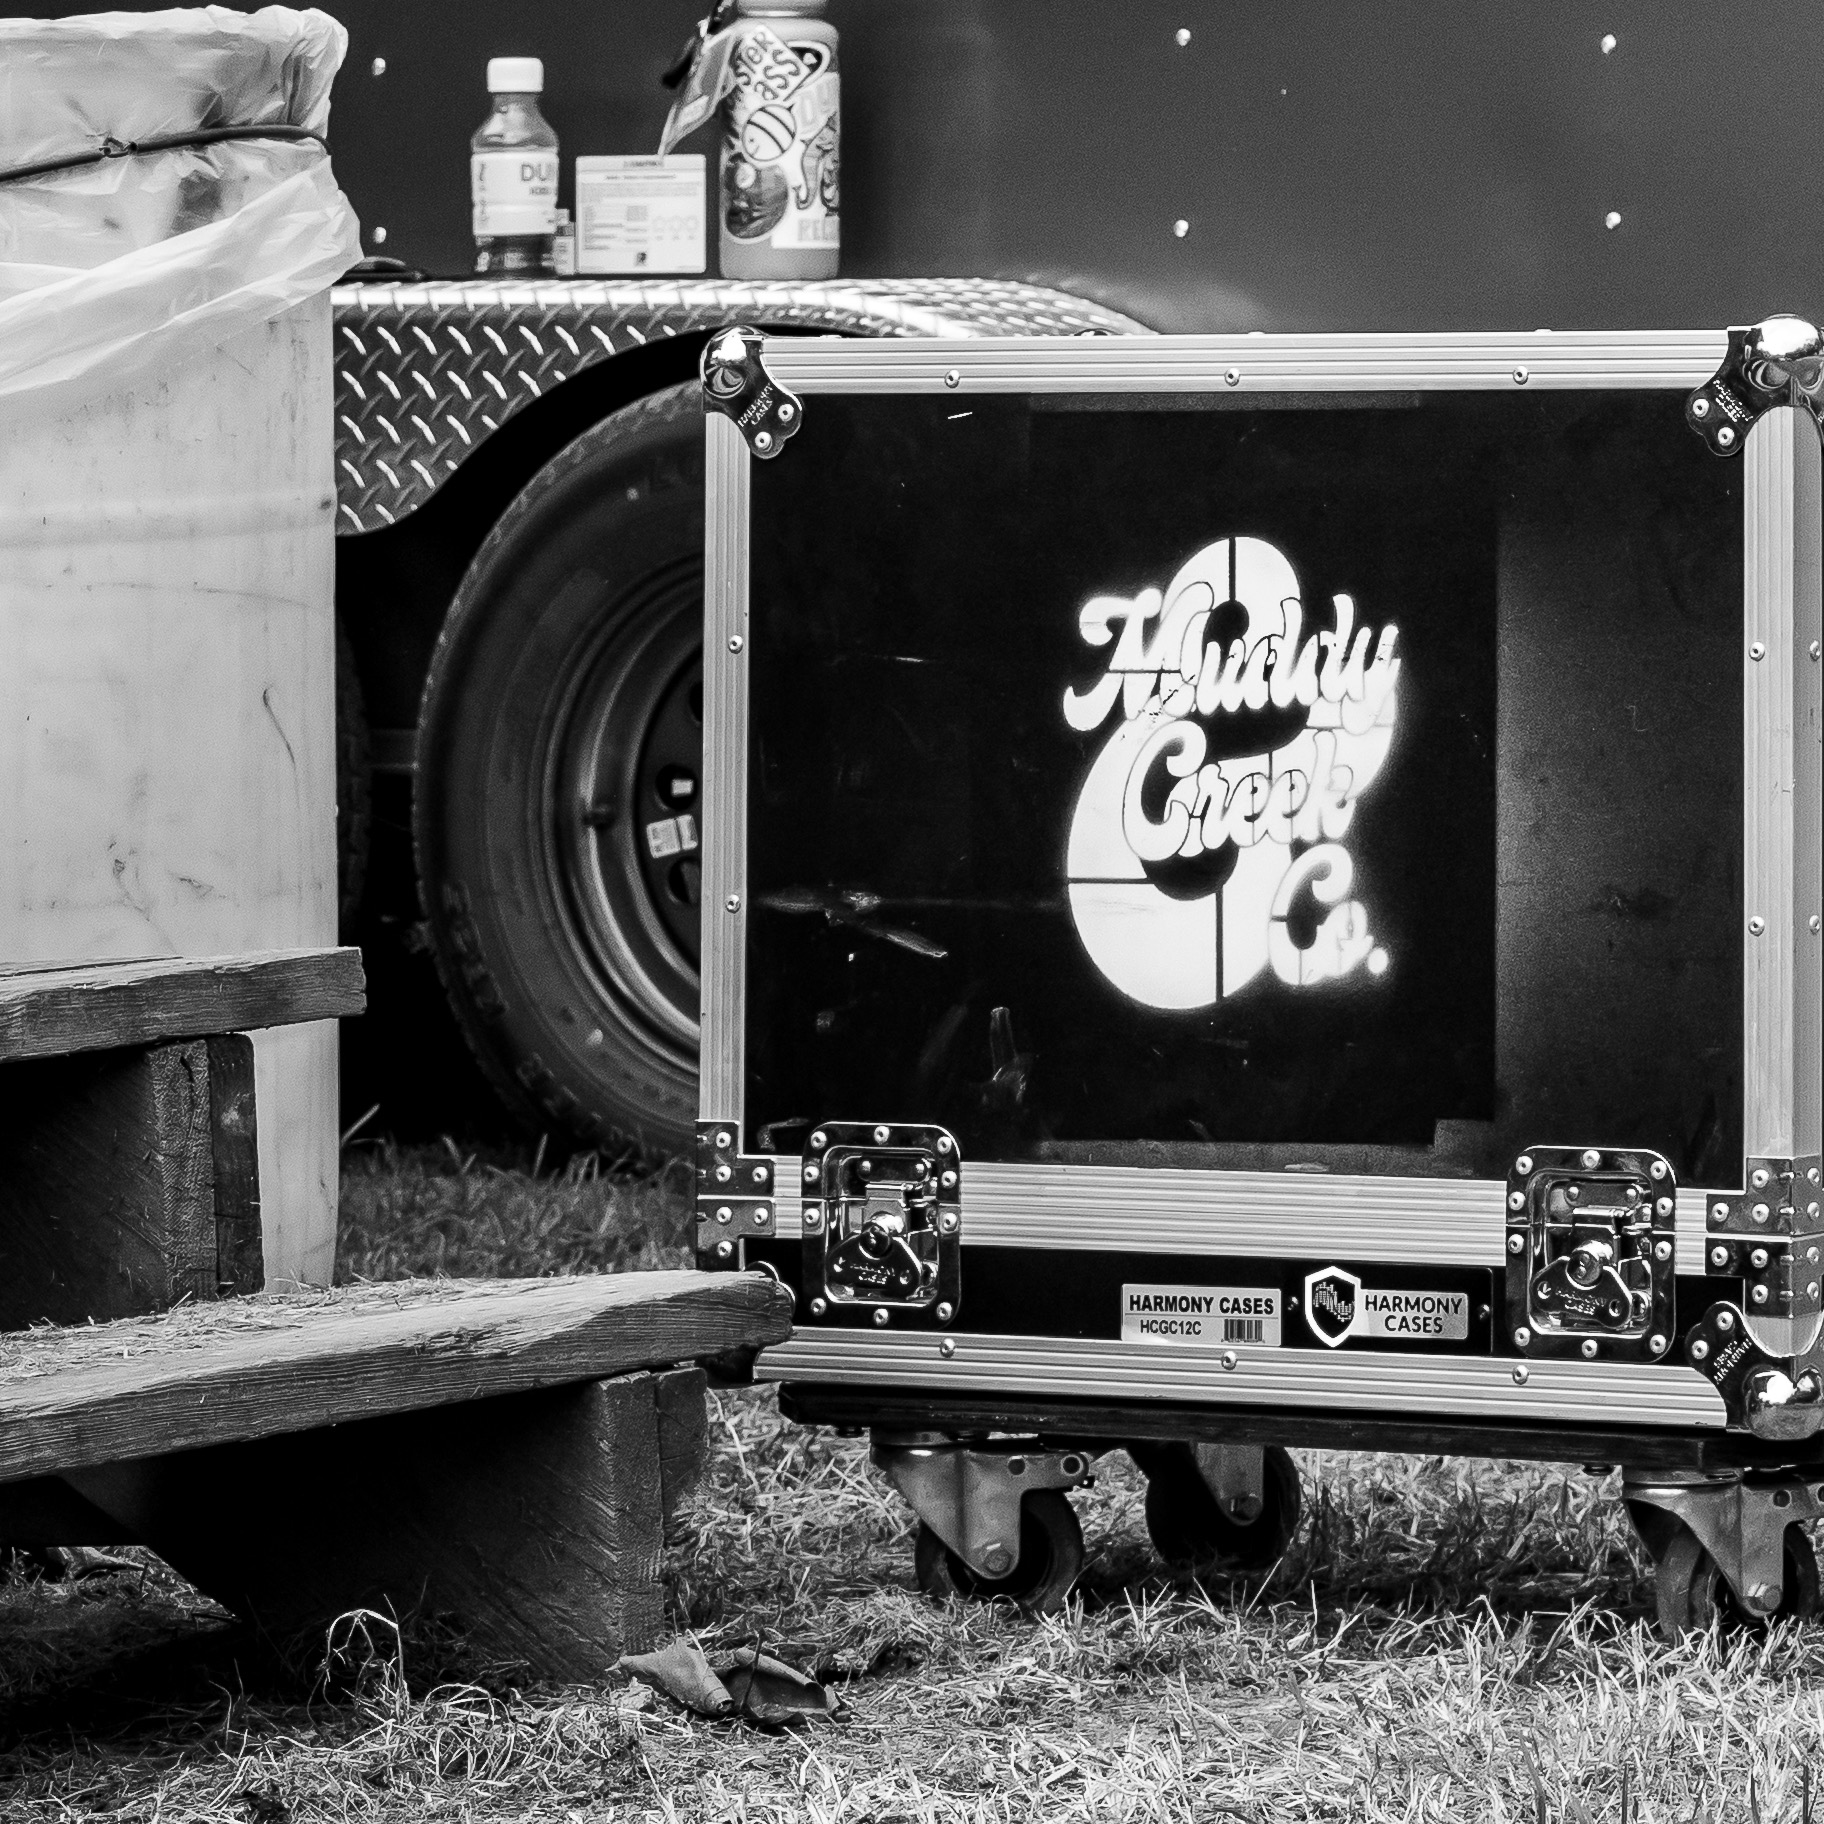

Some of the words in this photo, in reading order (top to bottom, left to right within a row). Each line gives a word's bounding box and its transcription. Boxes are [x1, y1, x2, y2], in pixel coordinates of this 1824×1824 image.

[1123, 719, 1356, 862] Creek
[1128, 1293, 1214, 1314] HARMONY
[1218, 1296, 1275, 1315] CASES
[1364, 1293, 1463, 1316] HARMONY
[1139, 1318, 1203, 1337] HCGC12C
[1383, 1315, 1444, 1334] CASES
